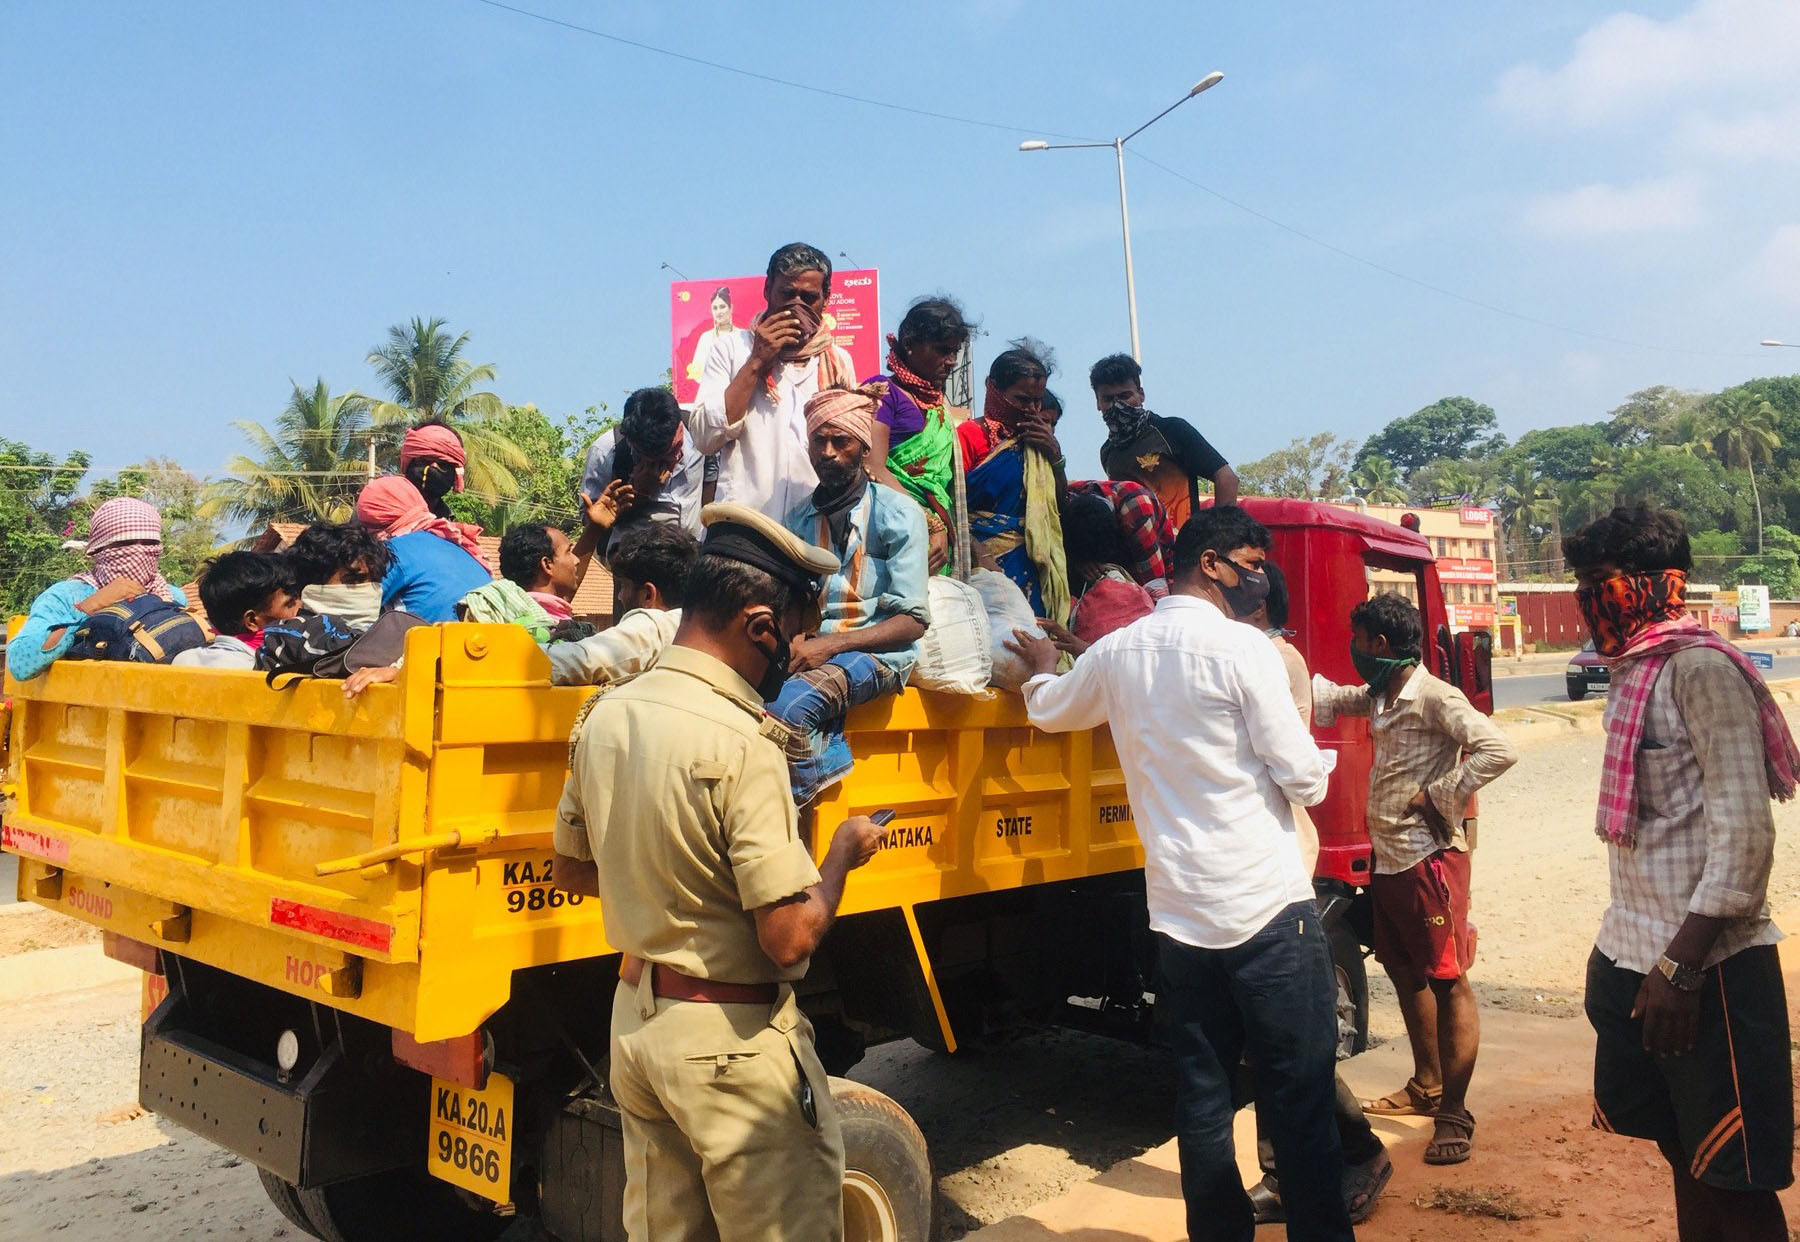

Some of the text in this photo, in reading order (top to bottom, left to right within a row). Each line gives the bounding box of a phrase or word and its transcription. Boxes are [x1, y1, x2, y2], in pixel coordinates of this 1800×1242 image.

[1464, 510, 1489, 521] LODGE
[879, 804, 1135, 850] NATAKA STATE PERMI
[503, 859, 553, 886] KA.2
[68, 886, 113, 919] SOUND
[507, 888, 584, 913] 9866
[285, 955, 332, 989] HOR
[437, 1087, 507, 1142] KA.20.A
[438, 1130, 501, 1184] 9866
